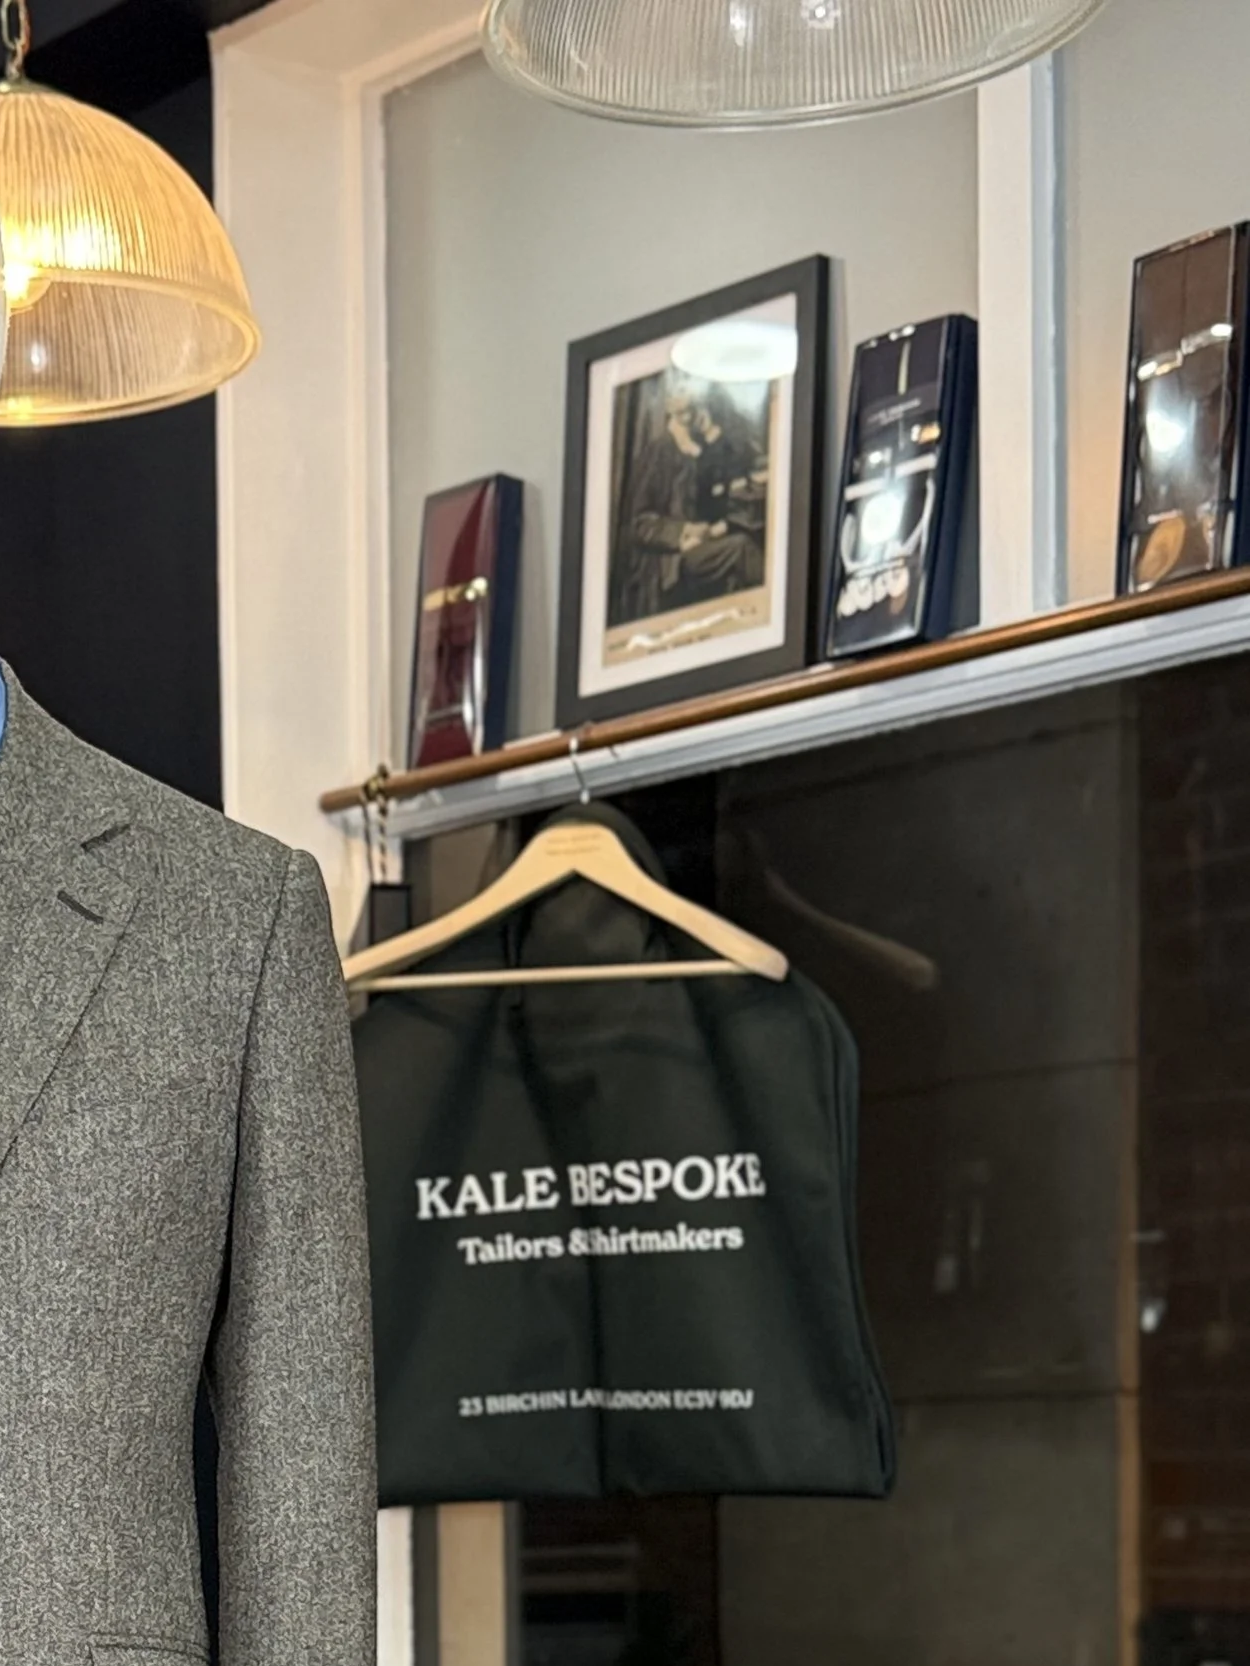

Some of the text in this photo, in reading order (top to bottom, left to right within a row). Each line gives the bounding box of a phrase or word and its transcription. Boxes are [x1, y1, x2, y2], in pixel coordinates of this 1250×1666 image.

[415, 1153, 766, 1219] KALE BESPOKE
[458, 1233, 565, 1265] Tailors
[568, 1226, 589, 1256] &
[486, 1391, 567, 1414] BIRCHIN
